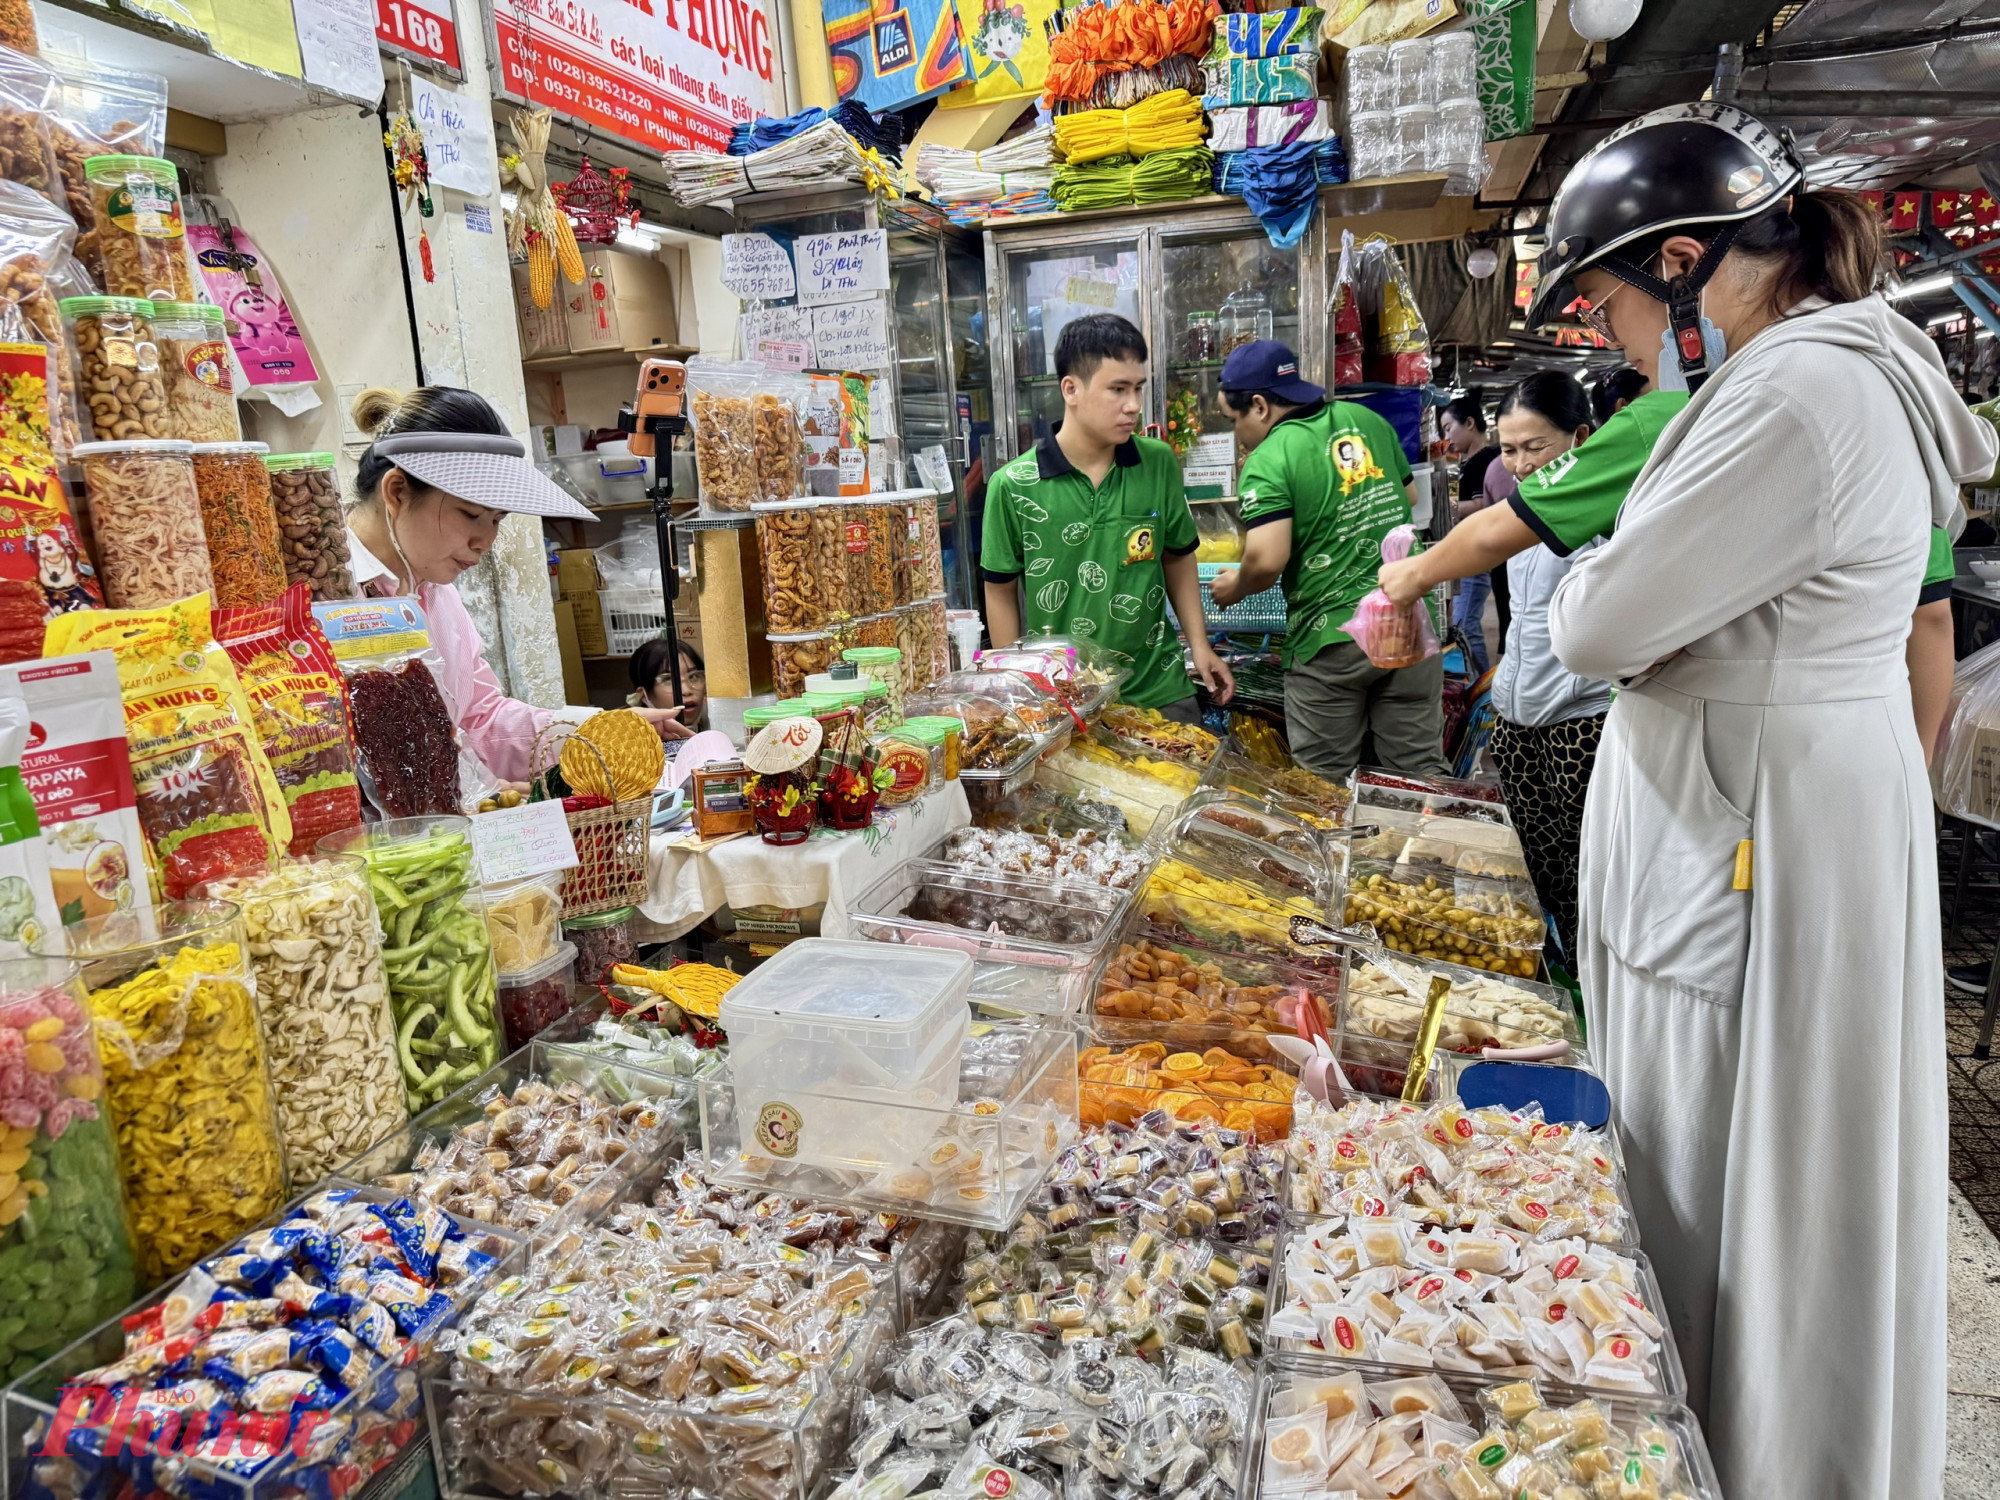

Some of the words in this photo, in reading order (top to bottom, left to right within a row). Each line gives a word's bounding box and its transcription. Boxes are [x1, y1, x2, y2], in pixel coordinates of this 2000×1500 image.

[375, 2, 444, 54] .168
[610, 36, 637, 66] các
[639, 45, 665, 83] loại
[669, 64, 705, 104] nhang
[708, 81, 728, 111] đèn
[881, 44, 909, 66] ALDI
[543, 76, 640, 127] 0937.126.509
[643, 118, 691, 149] (PHỤNG)
[548, 54, 652, 112] (028)39521220
[663, 106, 683, 126] NR:
[20, 669, 50, 680] EXOTIC
[51, 665, 79, 676] FRUITS
[897, 754, 911, 762] CON
